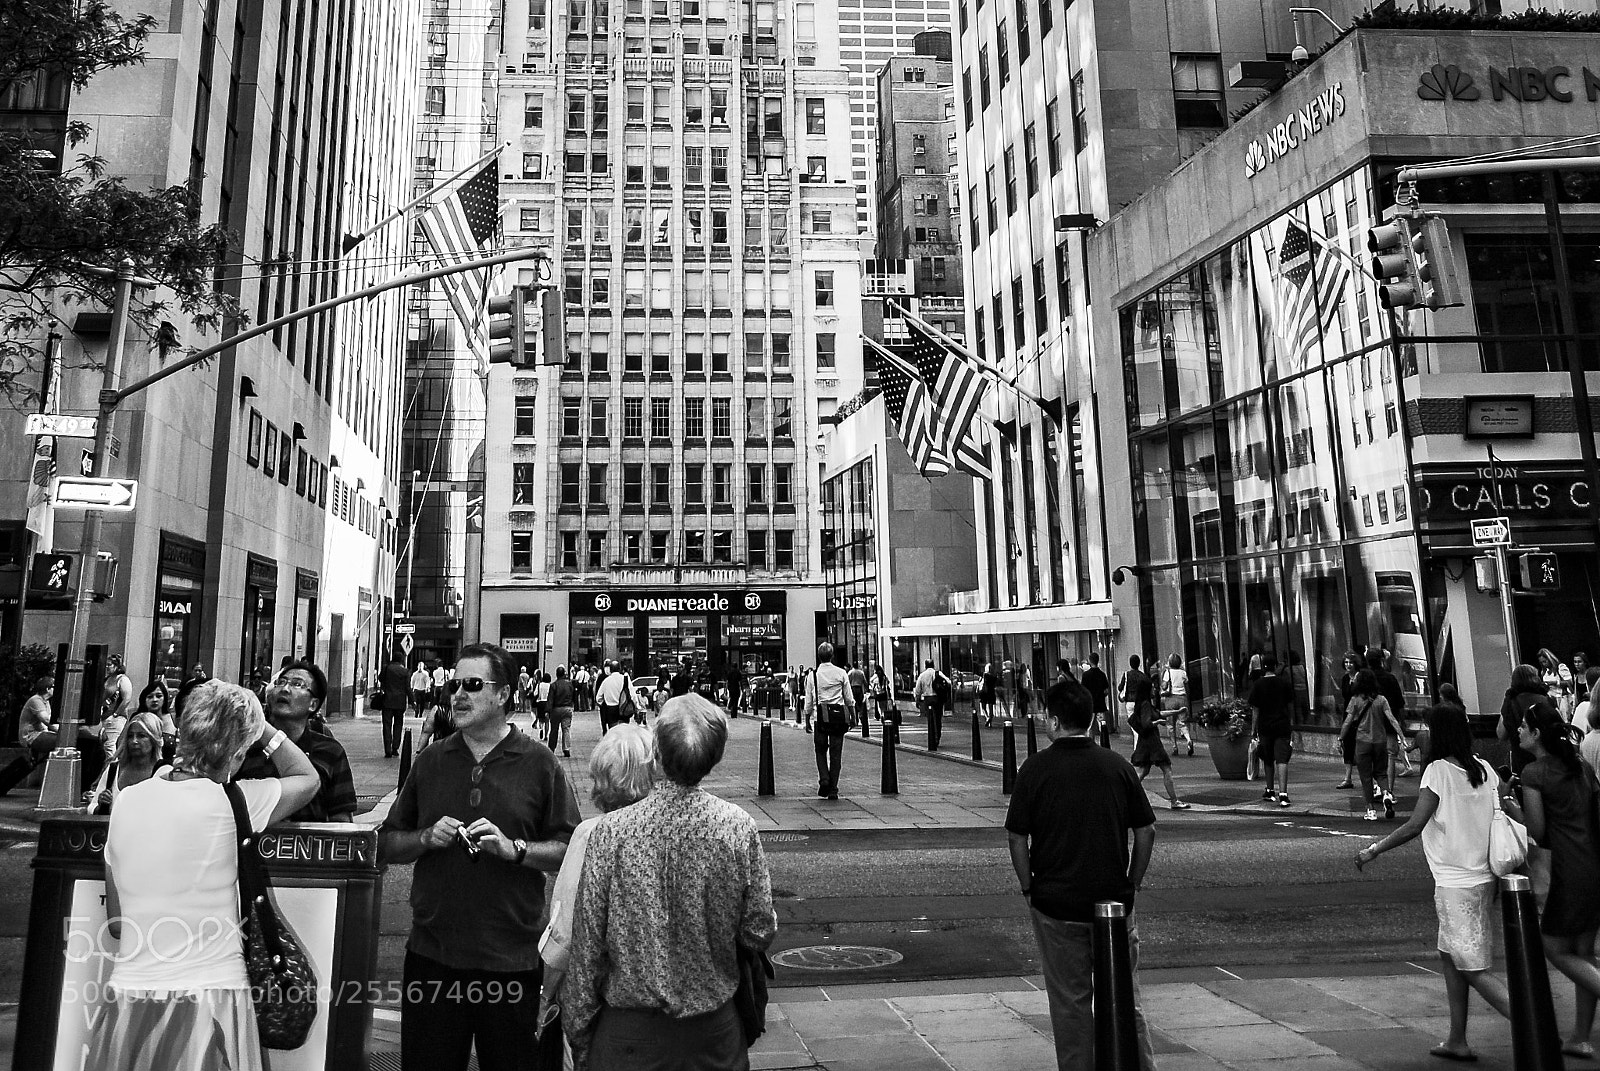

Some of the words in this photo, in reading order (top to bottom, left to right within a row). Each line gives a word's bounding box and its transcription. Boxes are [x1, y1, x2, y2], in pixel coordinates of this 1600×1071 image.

[1489, 65, 1573, 103] NBC
[1266, 113, 1299, 164] NBC
[1299, 82, 1346, 141] NEWS
[1476, 467, 1518, 479] TODAY
[1451, 483, 1551, 511] CALLS
[1477, 527, 1489, 537] ONE
[726, 624, 766, 636] pharmacy
[257, 832, 369, 864] CENTER
